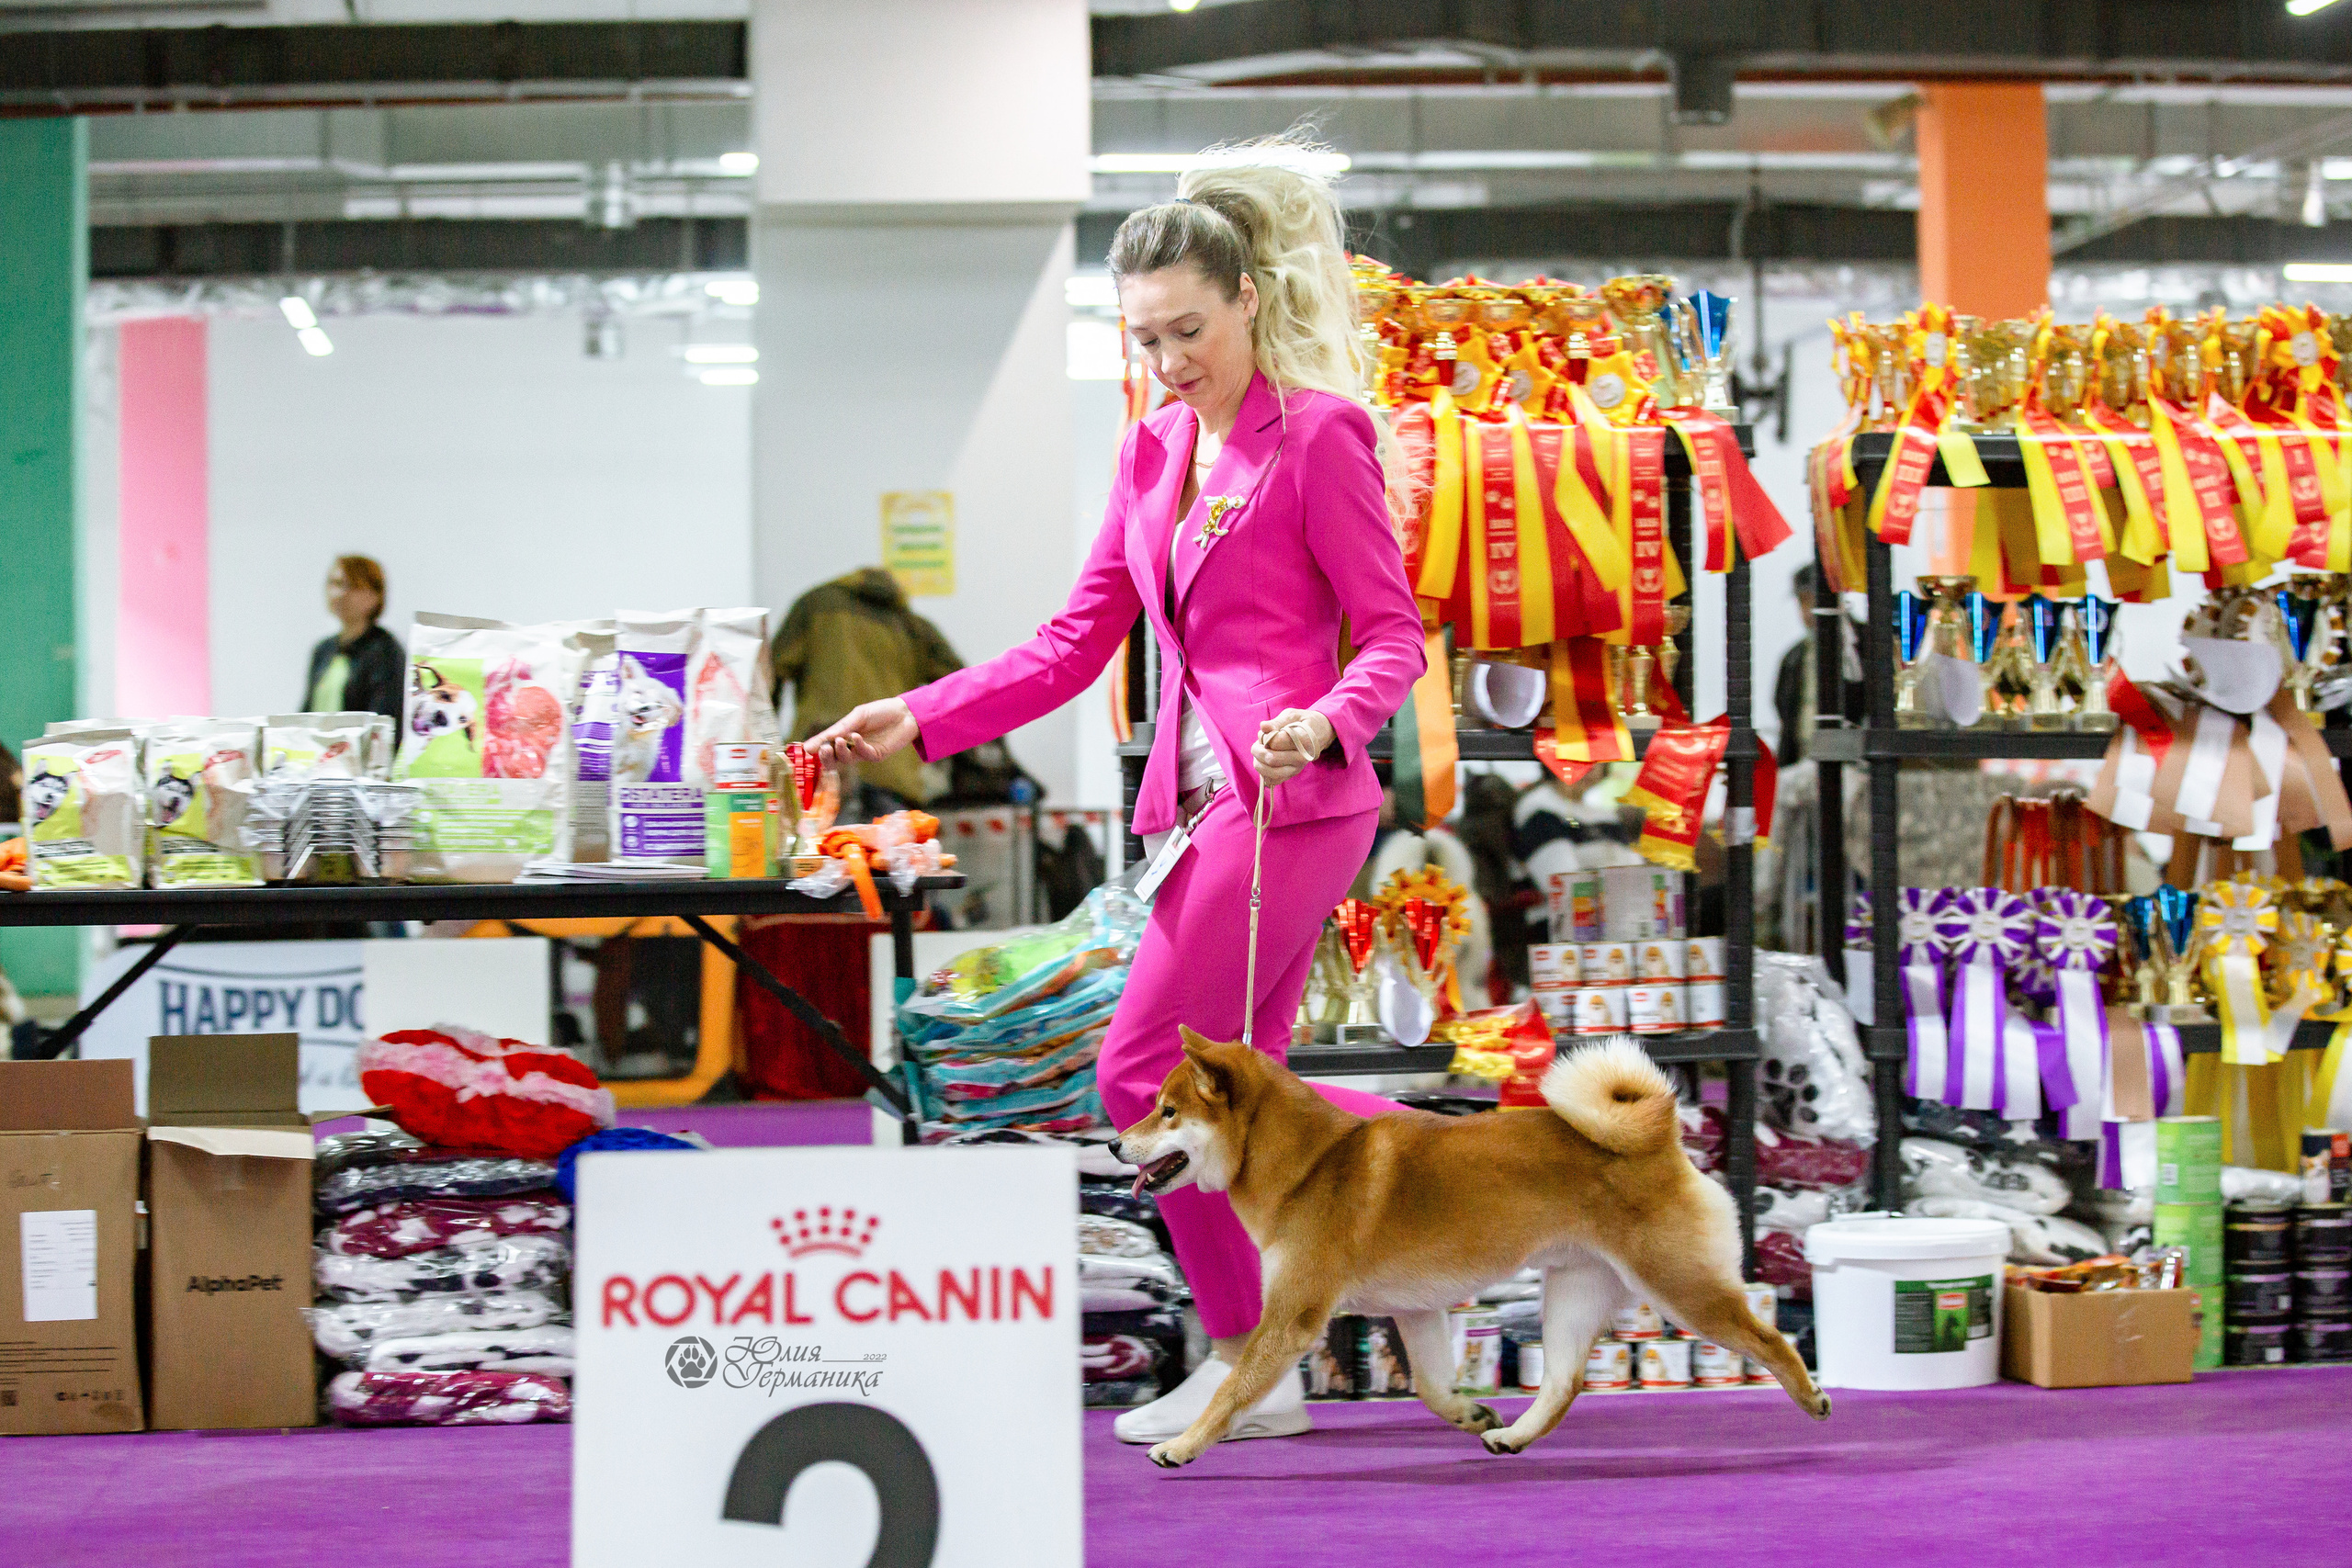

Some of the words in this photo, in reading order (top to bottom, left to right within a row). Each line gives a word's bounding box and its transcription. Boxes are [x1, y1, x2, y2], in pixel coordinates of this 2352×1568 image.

[159, 980, 305, 1035] HAPPY
[186, 1273, 285, 1296] AlphaPet
[601, 1270, 814, 1329] ROYAL
[834, 1264, 1056, 1324] CANIN
